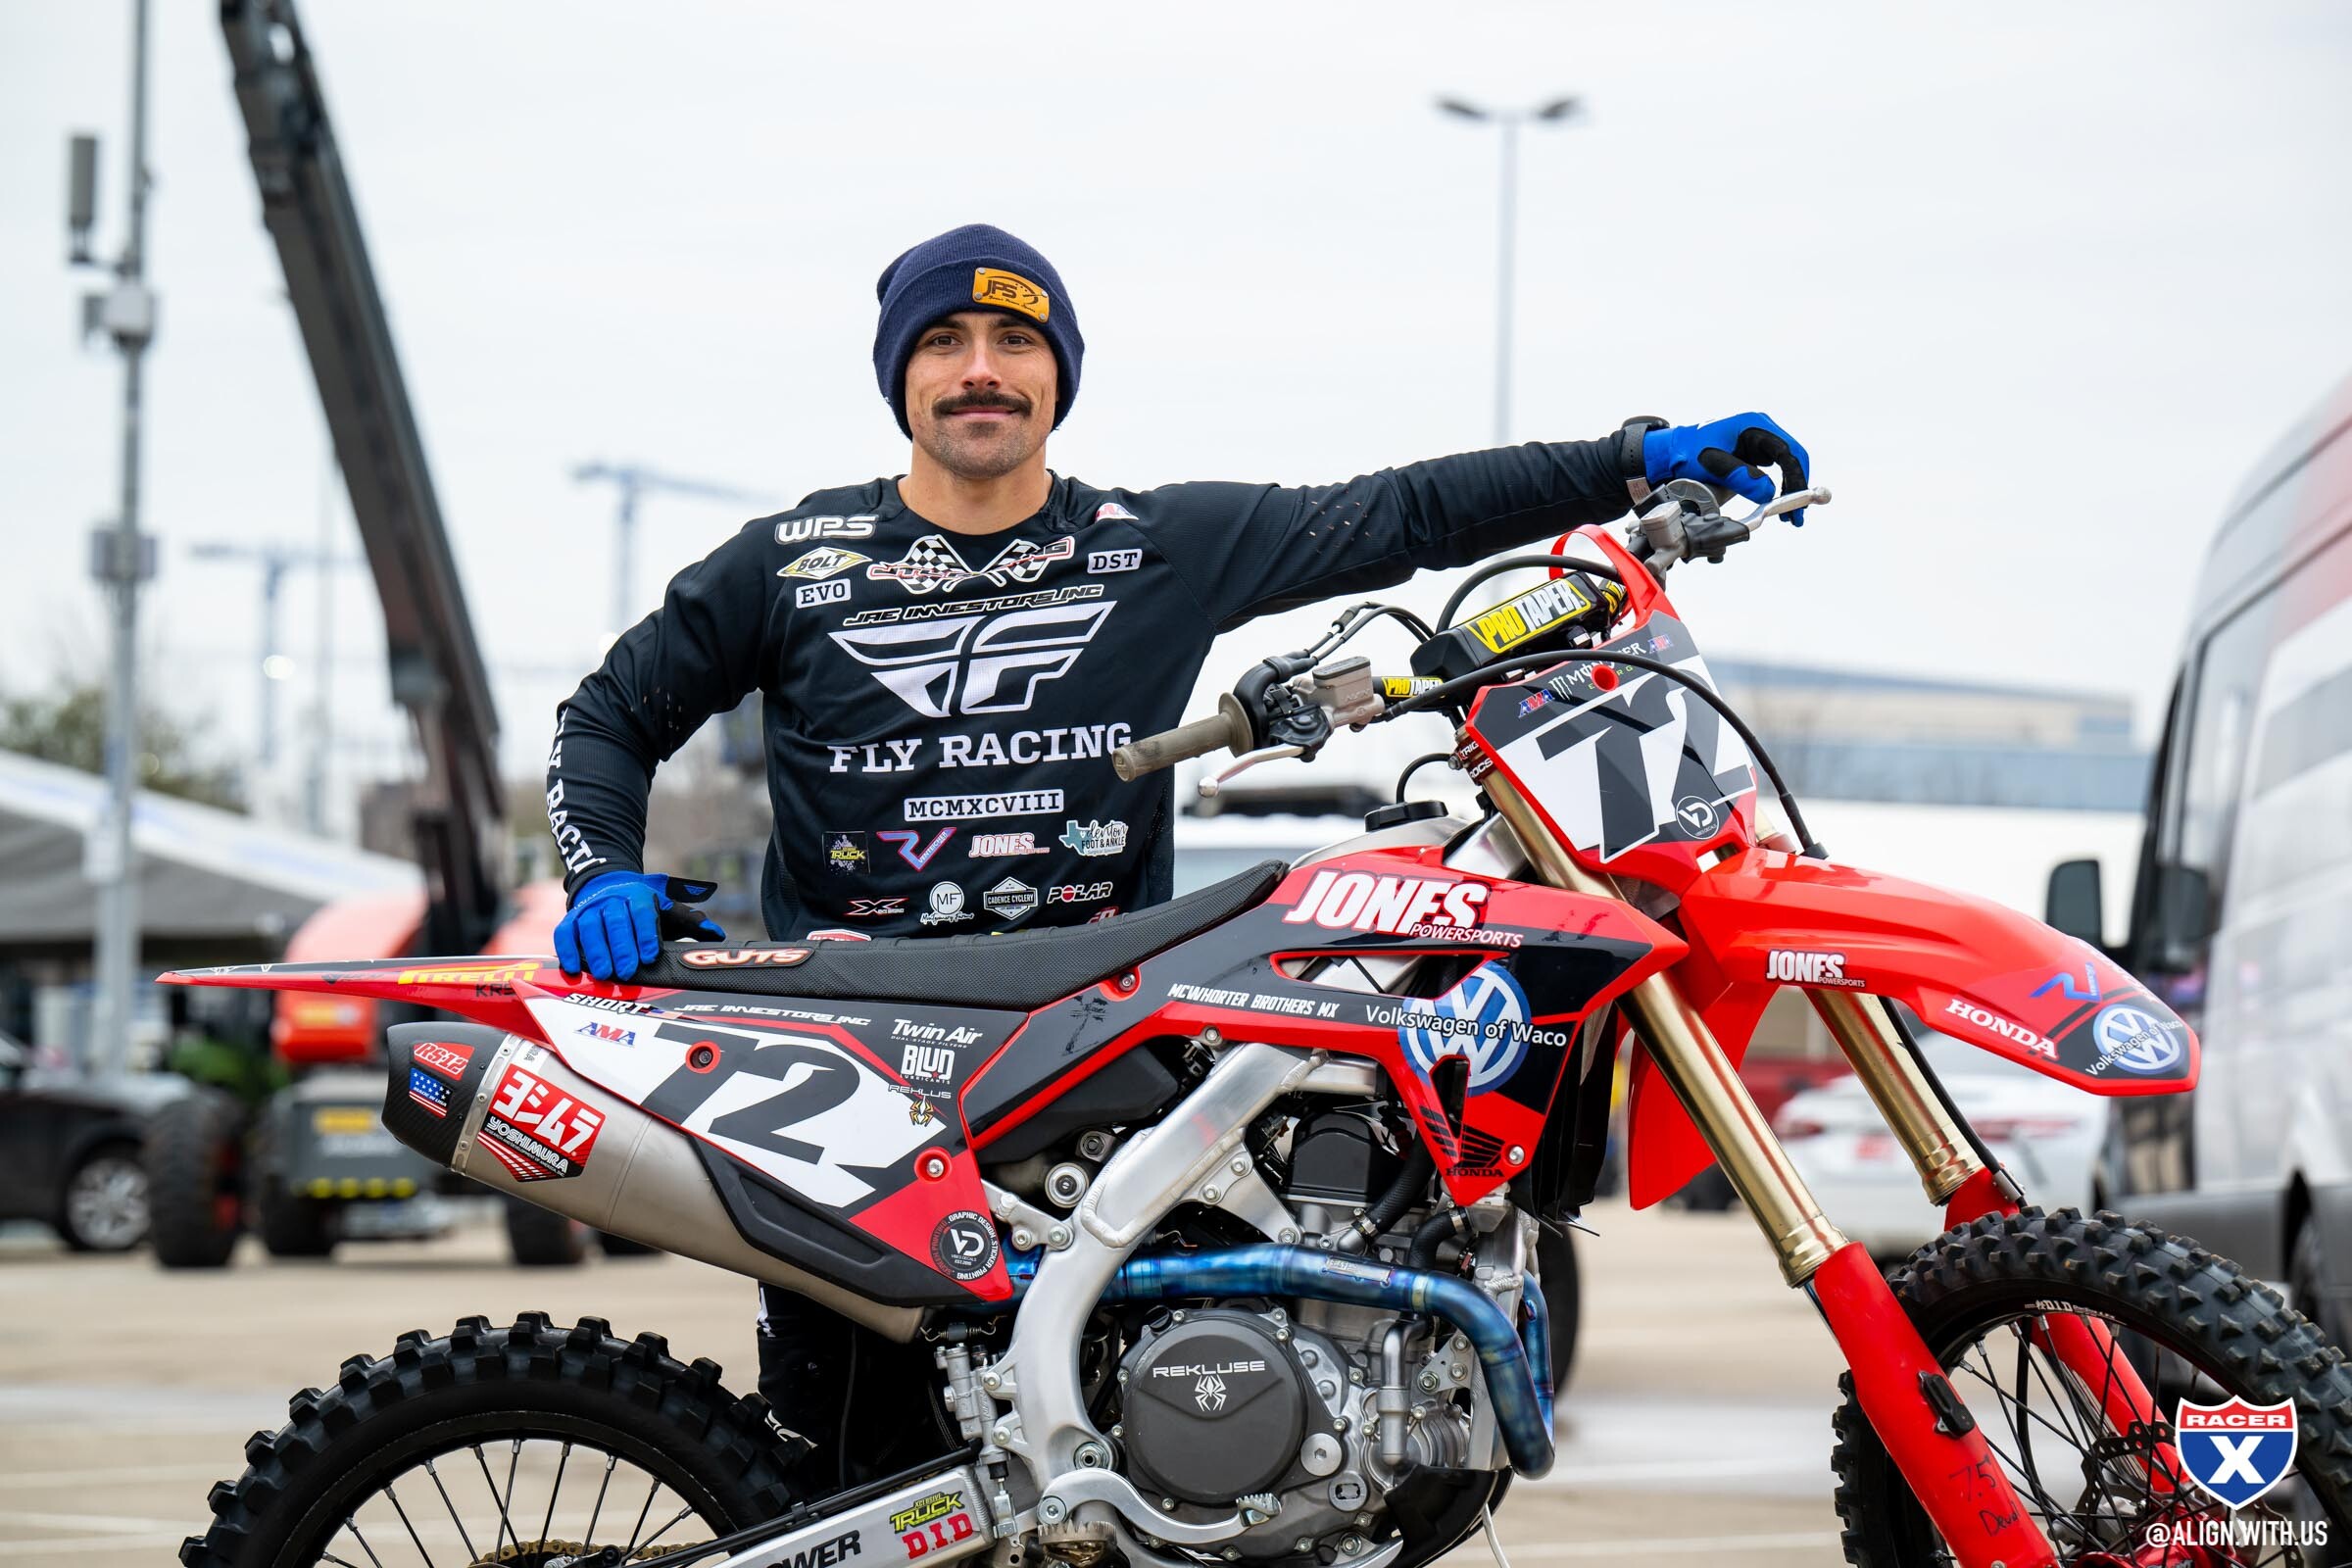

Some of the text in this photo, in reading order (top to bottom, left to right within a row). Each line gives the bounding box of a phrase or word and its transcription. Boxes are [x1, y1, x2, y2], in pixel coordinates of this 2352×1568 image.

[776, 514, 878, 544] WPS
[796, 553, 848, 572] BOLT
[1091, 552, 1138, 570] DST
[800, 582, 846, 605] EVO
[844, 609, 902, 625] JAE
[1476, 581, 1585, 645] PROTAPER
[1518, 688, 1556, 718] AMA
[827, 722, 1132, 773] FLY RACING
[1535, 669, 1756, 860] 72
[907, 792, 1060, 818] MCMXCVIII
[830, 849, 865, 860] TRUCK
[969, 833, 1035, 858] JONES
[1081, 839, 1099, 850] FOOT
[1105, 836, 1125, 848] ANKLE
[987, 893, 1034, 906] CADENCE CYCLERY
[1047, 882, 1113, 904] POLAR
[1284, 869, 1490, 934] JONES
[1408, 922, 1524, 949] POWERSPORTS
[682, 948, 810, 966] GUTS
[1766, 950, 1845, 983] JONES
[398, 962, 540, 985] PIRELLI
[1818, 976, 1866, 988] POWERSPORTS
[1167, 983, 1341, 1019] MCWHORTER BROTHERS MX
[573, 1021, 636, 1048] AMA
[892, 1018, 984, 1045] Twin Air
[1365, 1004, 1568, 1048] Volkswagen of Waco
[1944, 998, 2058, 1059] HONDA
[901, 1044, 956, 1081] BLUD
[2084, 1030, 2151, 1077] Volkswagen
[900, 1073, 951, 1085] LUBRICANTS
[413, 1086, 430, 1099] MADE
[436, 1098, 448, 1108] USA
[641, 1022, 860, 1165] 72
[492, 1070, 602, 1154] ヨシムラ
[486, 1115, 569, 1174] YOSHIMURA
[1446, 1167, 1505, 1177] HONDA
[1152, 1360, 1265, 1378] REKLUSE
[890, 1493, 963, 1532] TRUCK
[914, 1493, 942, 1508] XCLUSIVE
[766, 1529, 862, 1568] WER
[902, 1512, 974, 1559] D.I.D
